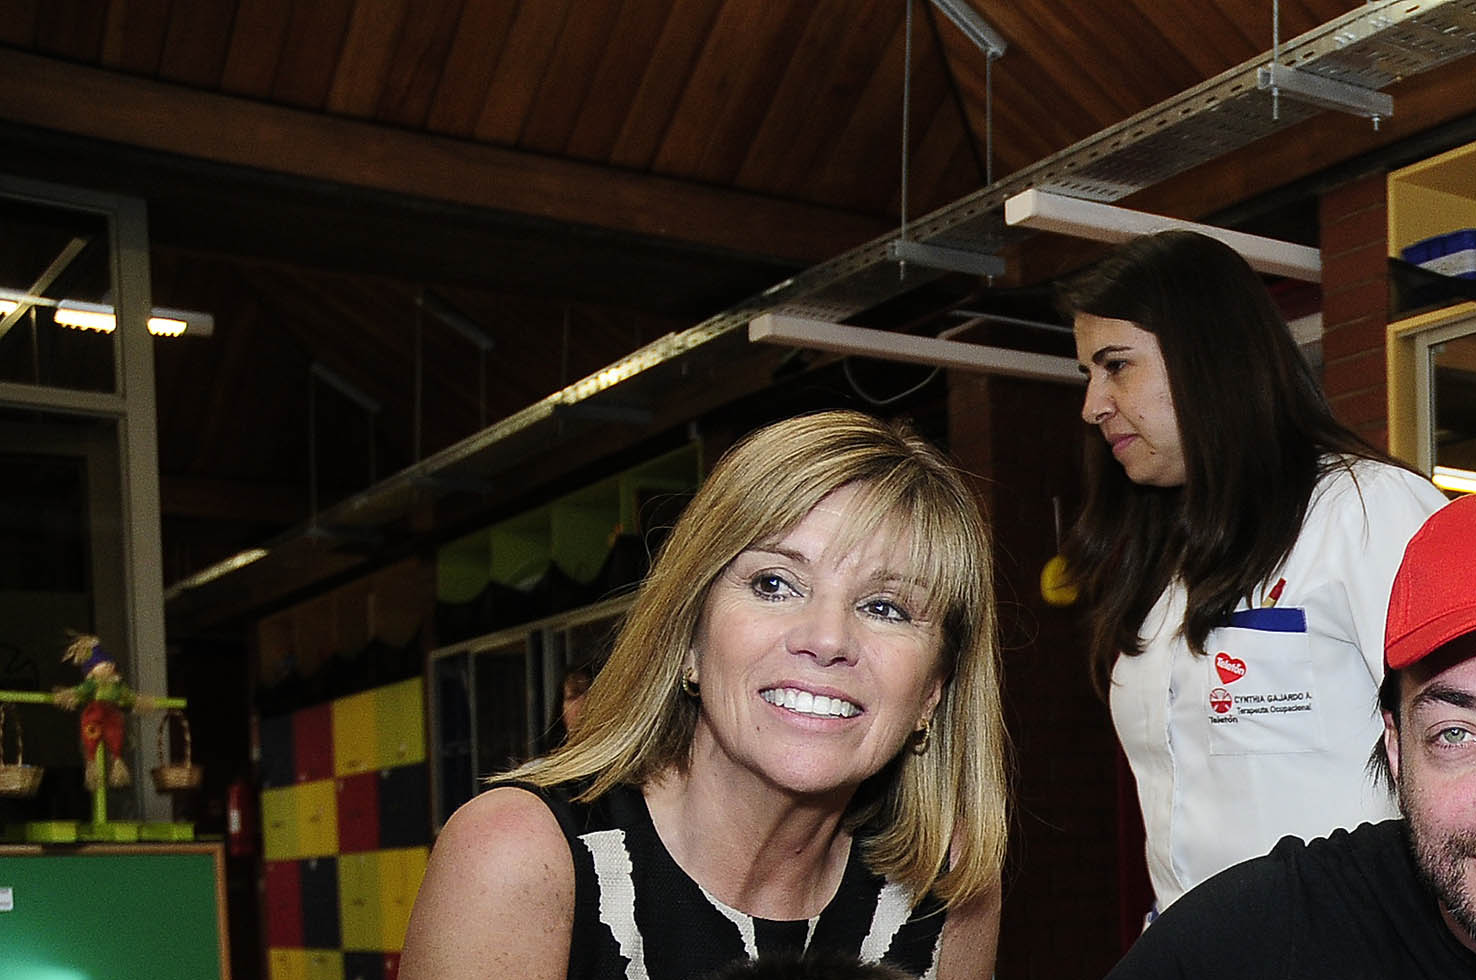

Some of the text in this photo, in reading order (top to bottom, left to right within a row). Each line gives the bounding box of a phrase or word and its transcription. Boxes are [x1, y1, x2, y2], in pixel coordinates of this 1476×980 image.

[1216, 656, 1245, 676] Teletón
[1234, 694, 1266, 704] CYNTHIA
[1267, 692, 1304, 703] GAJARDO
